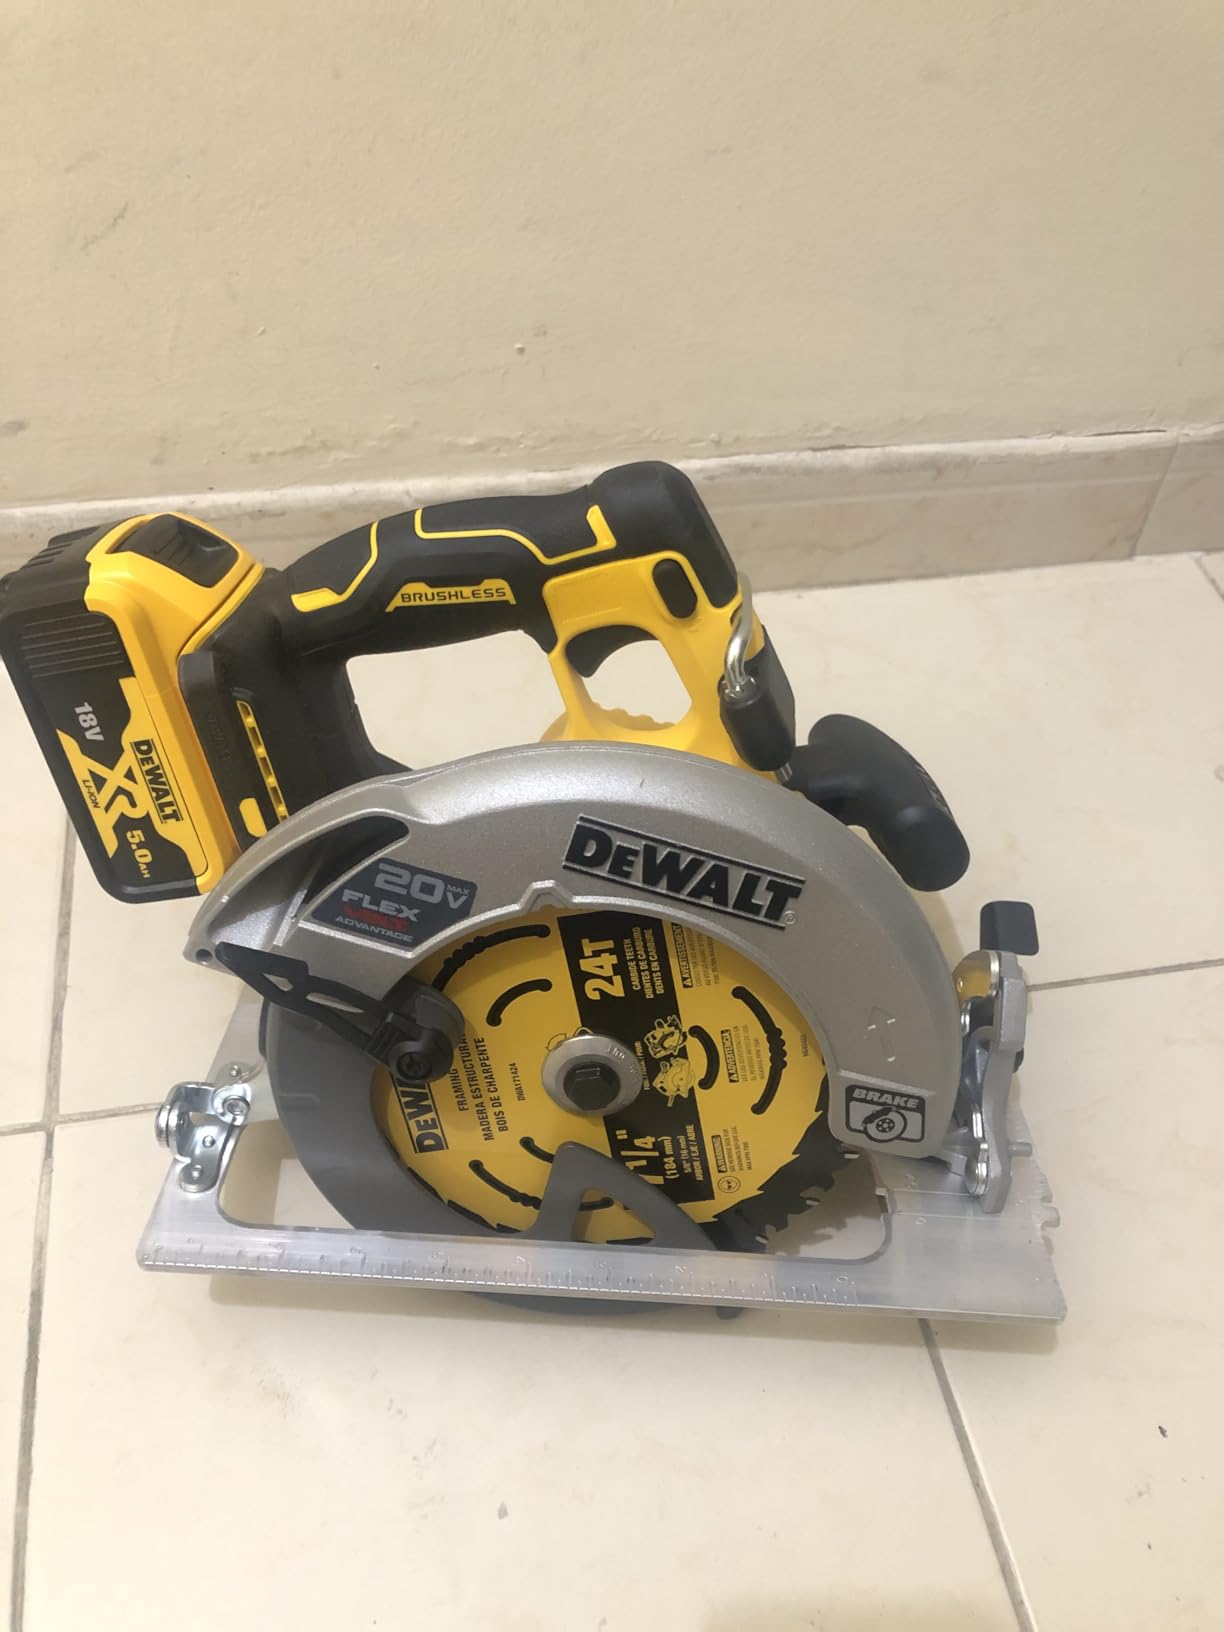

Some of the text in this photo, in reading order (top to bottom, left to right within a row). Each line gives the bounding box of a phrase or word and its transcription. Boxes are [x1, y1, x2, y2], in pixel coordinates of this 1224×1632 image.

[401, 587, 507, 603] BRUSHLESS
[74, 701, 104, 741] 18V
[82, 778, 101, 809] LI-ION
[132, 739, 182, 824] DEWALT
[447, 884, 470, 896] MAX
[564, 821, 804, 923] DEWALT
[341, 888, 421, 922] FLEX
[335, 915, 414, 943] ADVANTAGE
[579, 938, 626, 1001] 24T
[623, 938, 641, 991] CARBIDE TEETH
[632, 927, 655, 999] DIENTES DE CARBURO
[644, 928, 665, 994] DENTS EN CARBURE
[448, 1068, 470, 1112] FRAMING
[458, 1034, 495, 1141] MADERA ESTRUCTURA
[474, 1037, 509, 1132] BOIS DE CHARPENTE
[508, 1062, 526, 1102] DWA171424
[852, 1088, 920, 1110] BRAKE
[399, 1086, 445, 1153] DEW
[657, 1136, 680, 1179] (184 mm)
